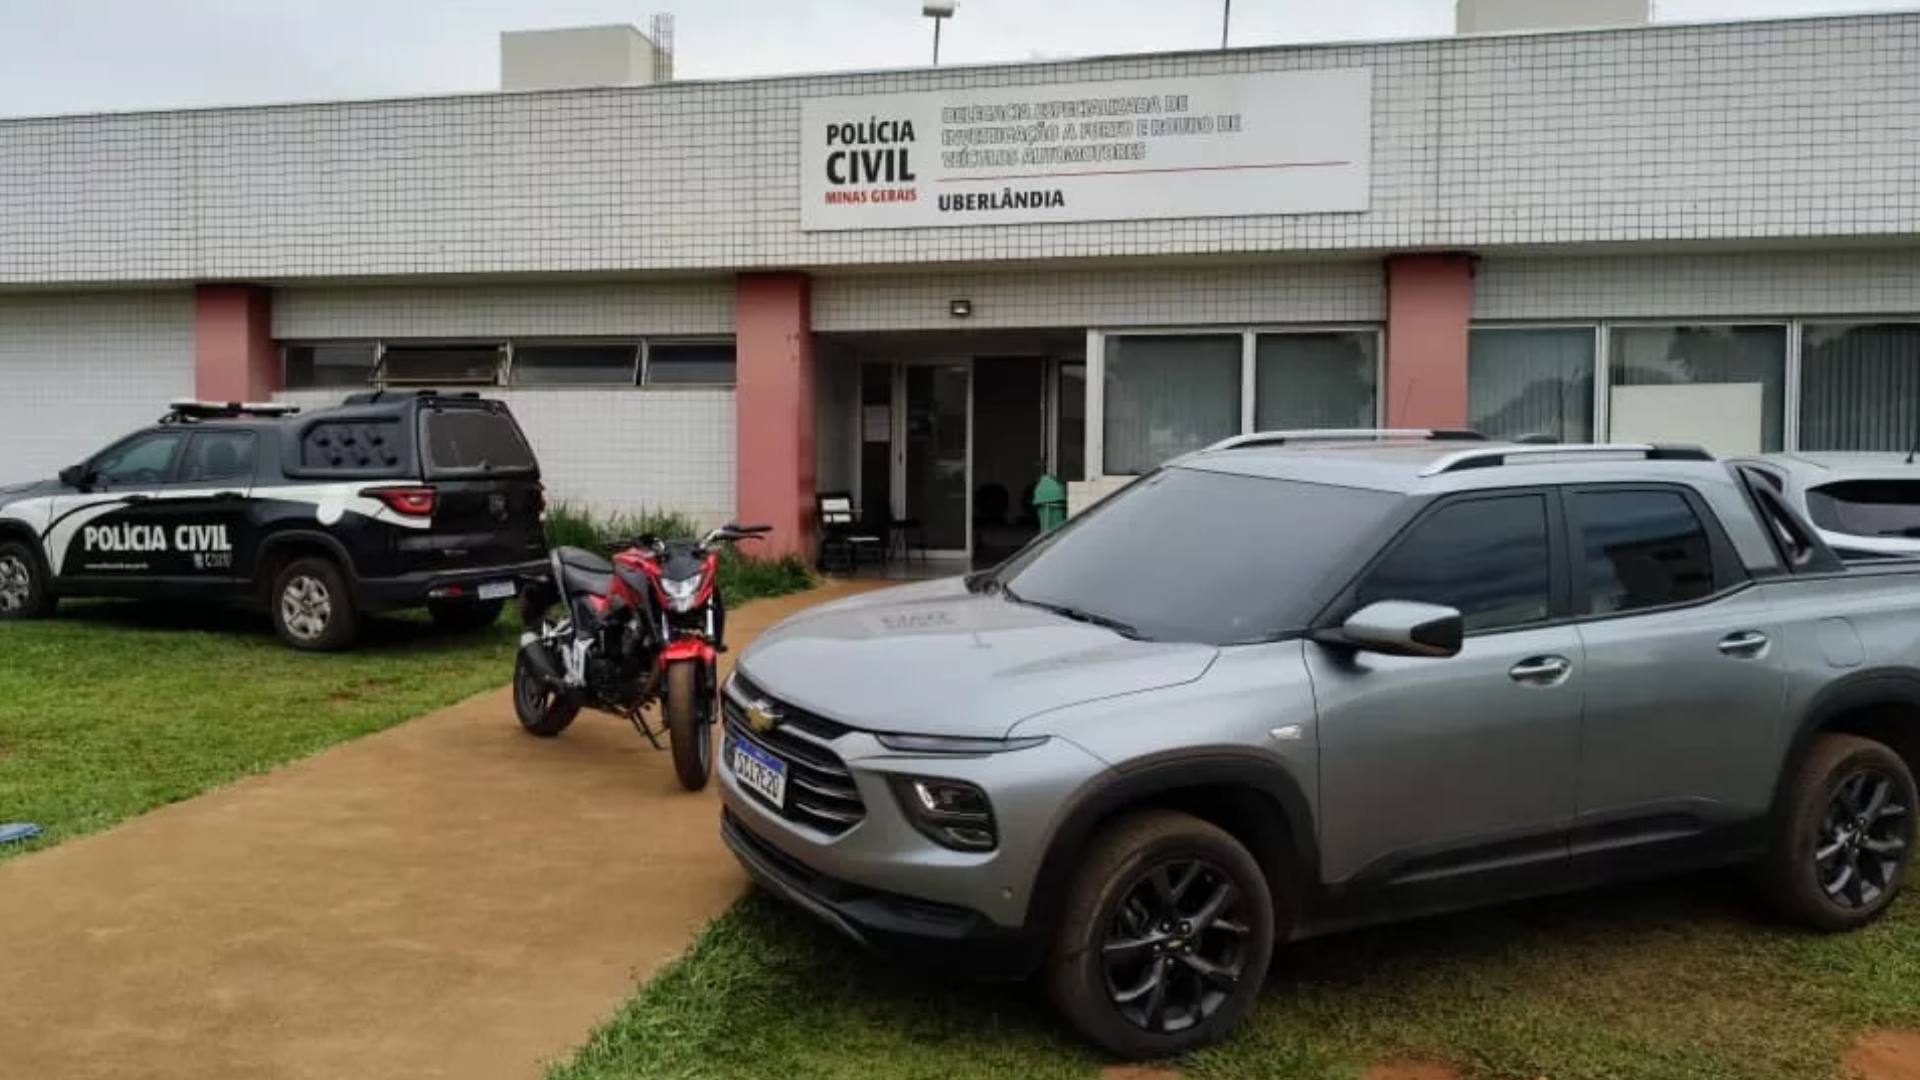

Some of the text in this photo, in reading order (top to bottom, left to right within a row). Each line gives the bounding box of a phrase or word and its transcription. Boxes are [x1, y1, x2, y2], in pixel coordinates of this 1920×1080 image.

[1165, 95, 1188, 112] DE
[826, 116, 915, 145] POLÍCIA
[1137, 119, 1148, 137] E
[1217, 114, 1242, 132] DE
[826, 148, 916, 184] CIVIL
[825, 188, 917, 204] MINAS GERAIS
[938, 188, 1065, 211] UBERLÂNDIA
[84, 522, 232, 551] POLÍCIA CIVIL
